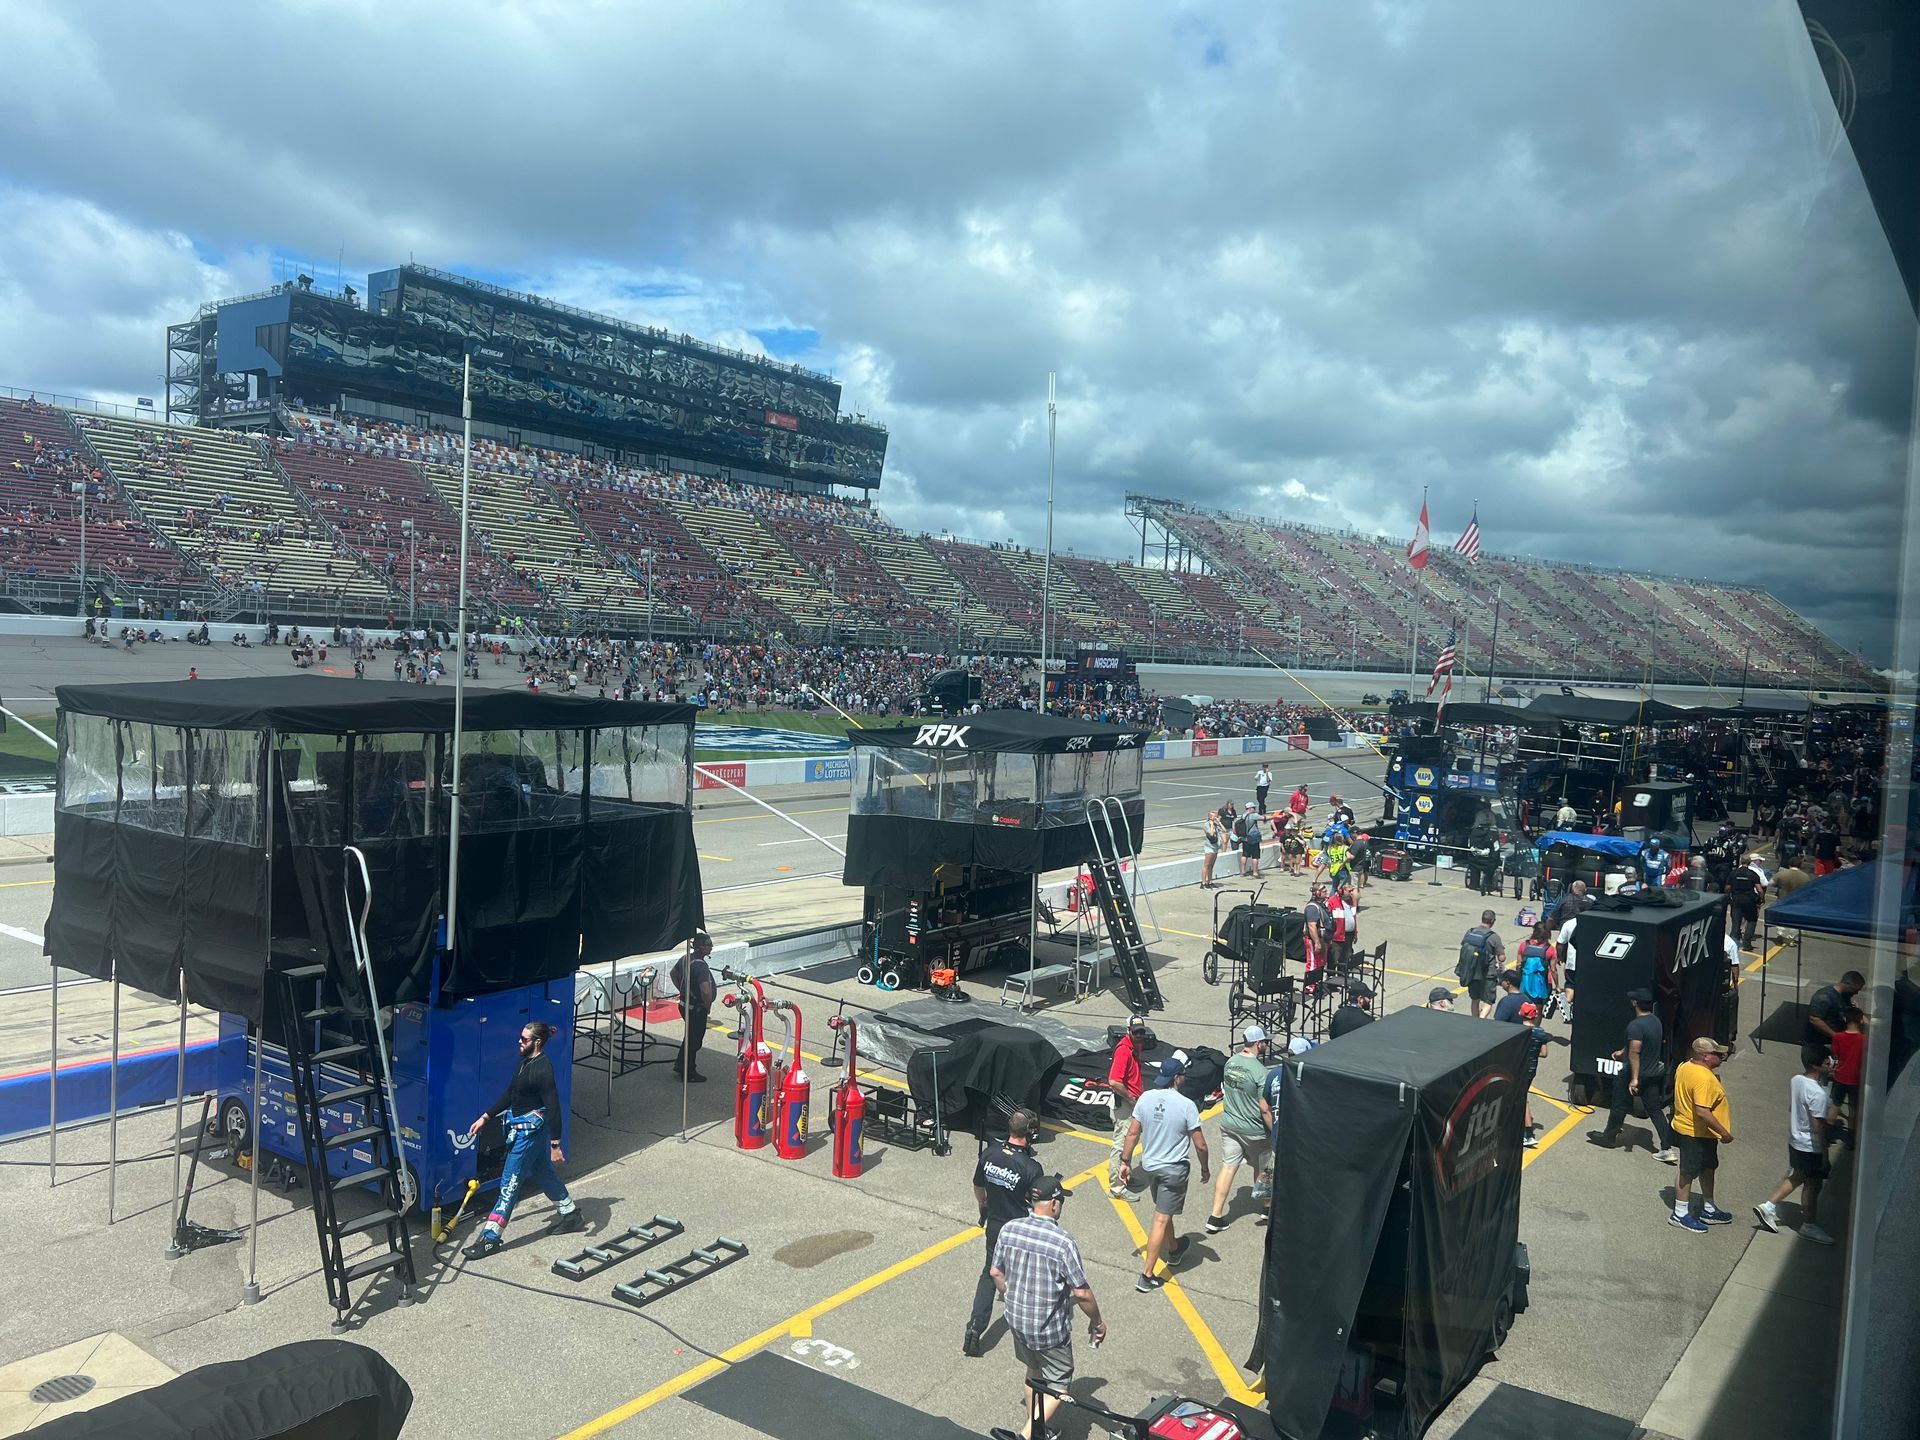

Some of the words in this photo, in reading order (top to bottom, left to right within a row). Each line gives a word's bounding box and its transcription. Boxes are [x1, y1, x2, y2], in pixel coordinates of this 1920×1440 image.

[1094, 657, 1119, 669] NASCAR
[912, 724, 971, 748] RFK
[1065, 736, 1093, 751] RFK
[825, 760, 850, 769] MICHIGA
[1417, 772, 1431, 781] NAPA
[1418, 800, 1431, 809] NAPA
[1633, 793, 1652, 808] 9
[1000, 816, 1021, 825] Castrol
[1596, 931, 1636, 960] 6
[1671, 915, 1713, 974] RFK
[1596, 1057, 1624, 1076] TUP
[800, 1104, 808, 1141] SUNOCO
[1457, 1095, 1503, 1158] jtg
[983, 1160, 1022, 1184] Hendrick
[500, 1172, 519, 1202] Kroger
